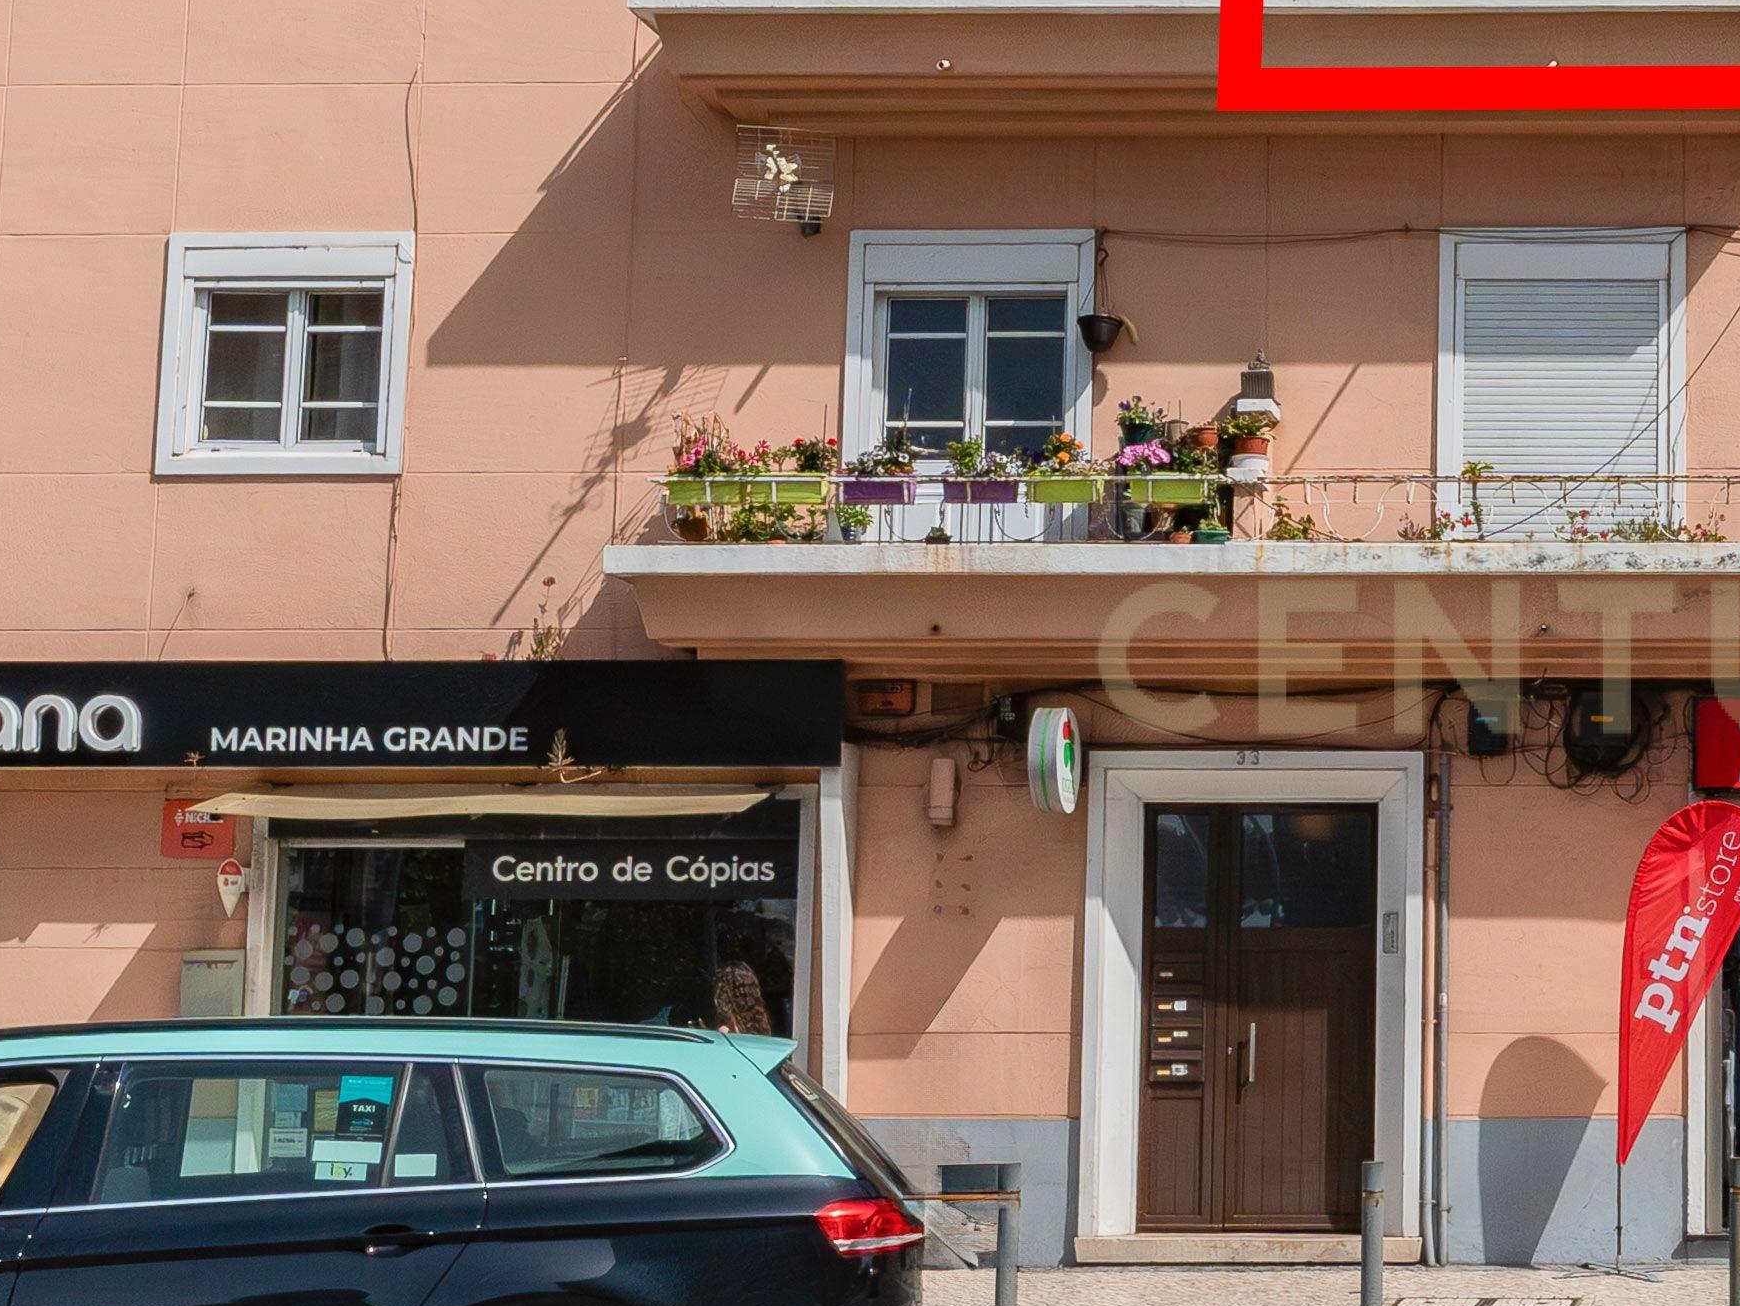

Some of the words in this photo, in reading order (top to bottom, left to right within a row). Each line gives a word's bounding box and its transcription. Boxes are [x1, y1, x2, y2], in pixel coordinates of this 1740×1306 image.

[211, 727, 374, 751] MARINHA
[384, 727, 529, 751] GRANDE
[492, 856, 599, 882] Centro
[612, 856, 653, 882] de
[666, 855, 775, 888] Cópias
[352, 1104, 376, 1113] TAXI
